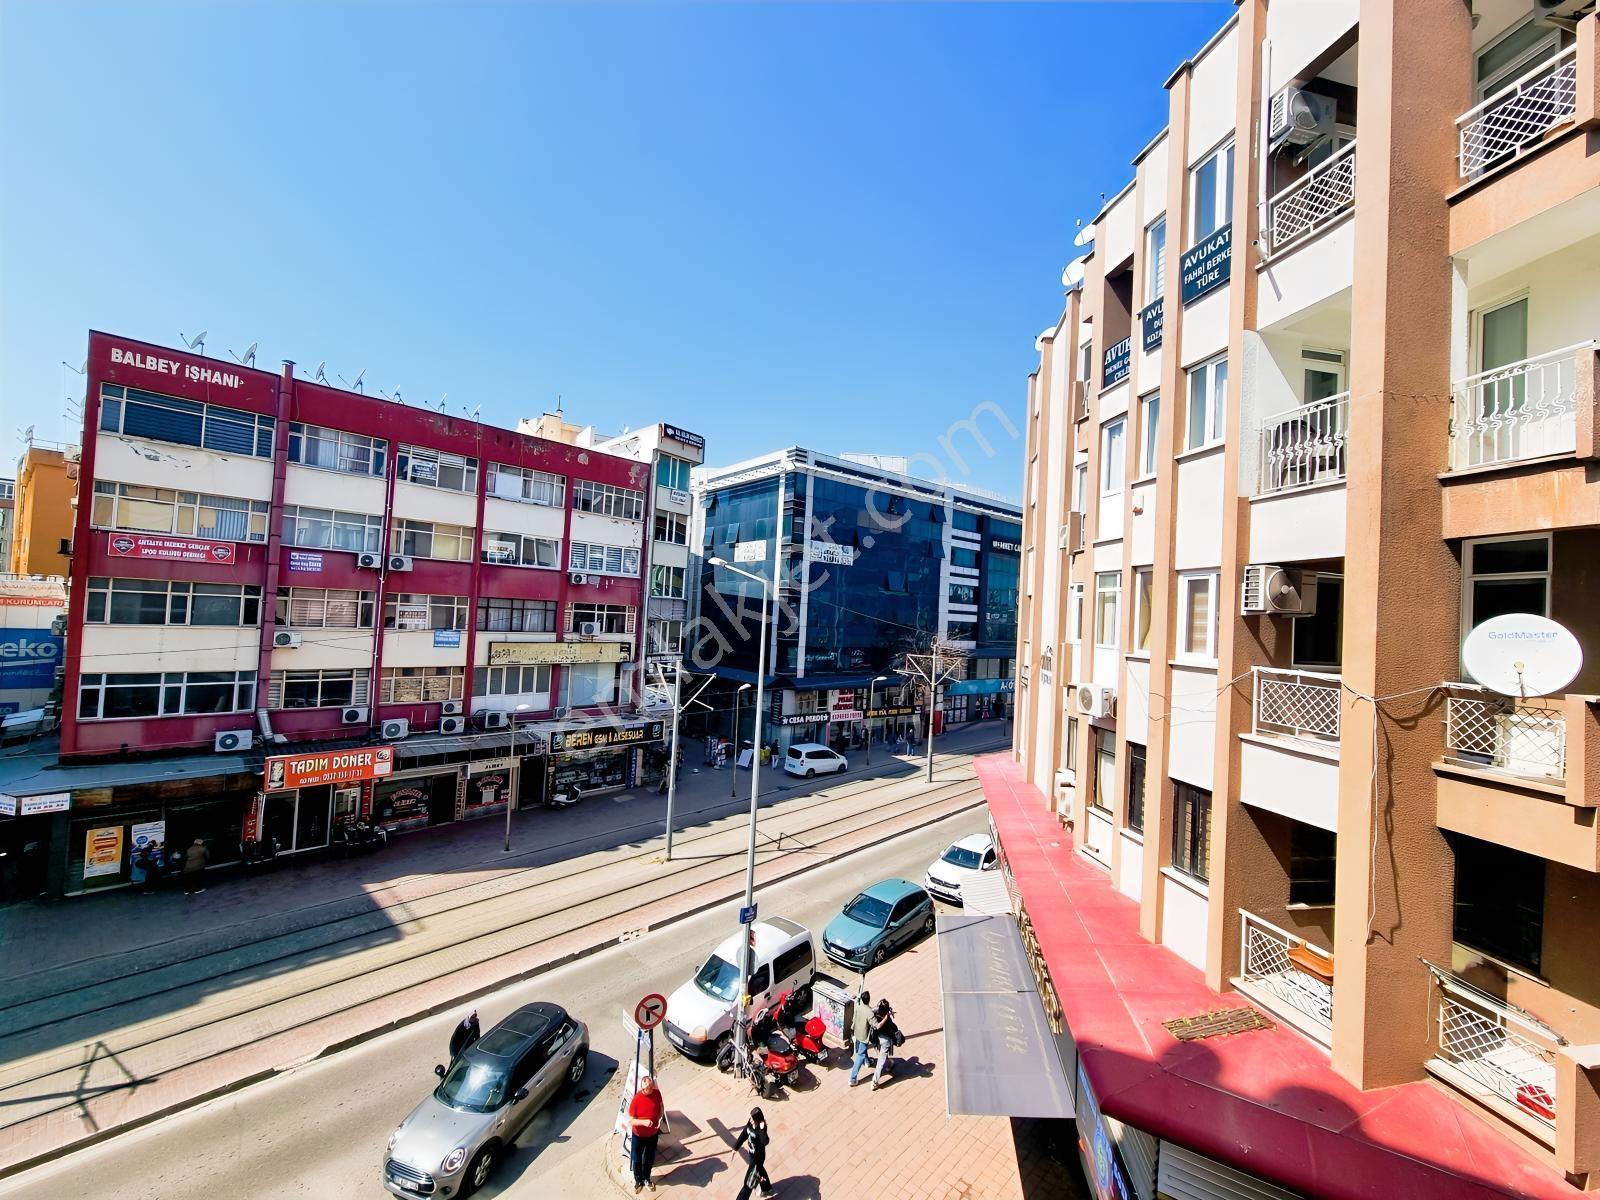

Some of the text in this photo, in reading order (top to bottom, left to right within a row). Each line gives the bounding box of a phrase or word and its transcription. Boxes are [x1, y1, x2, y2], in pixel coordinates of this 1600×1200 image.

[1183, 228, 1232, 271] AVUKAT
[1184, 246, 1232, 285] FAHRİ BERKE
[1196, 267, 1220, 290] TÜRE
[111, 347, 181, 376] BALBEY
[1488, 631, 1558, 640] GoldMaster
[290, 752, 372, 774] TADIM DÖNER
